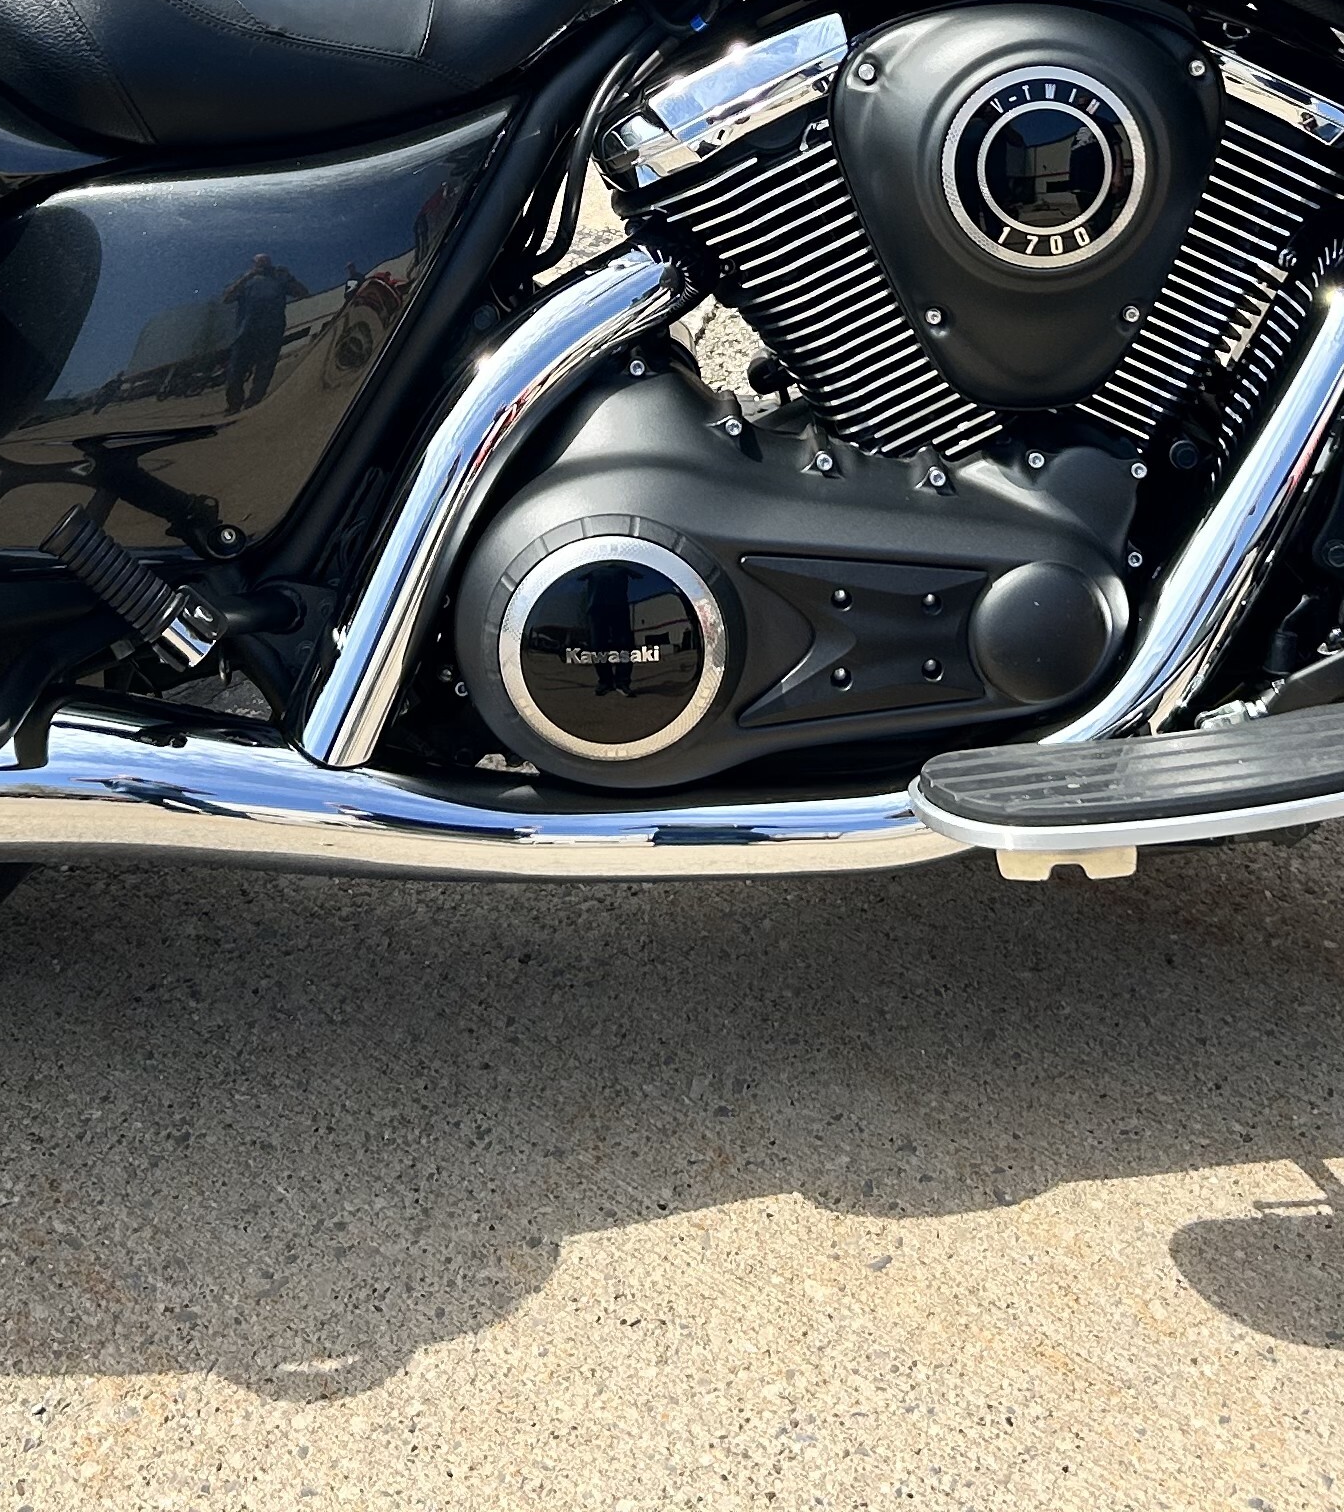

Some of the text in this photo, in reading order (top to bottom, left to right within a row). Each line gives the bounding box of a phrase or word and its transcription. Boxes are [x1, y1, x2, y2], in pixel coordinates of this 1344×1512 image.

[989, 83, 1101, 115] V-TWIN
[997, 226, 1091, 255] 1700
[565, 645, 660, 664] Kawasaki
